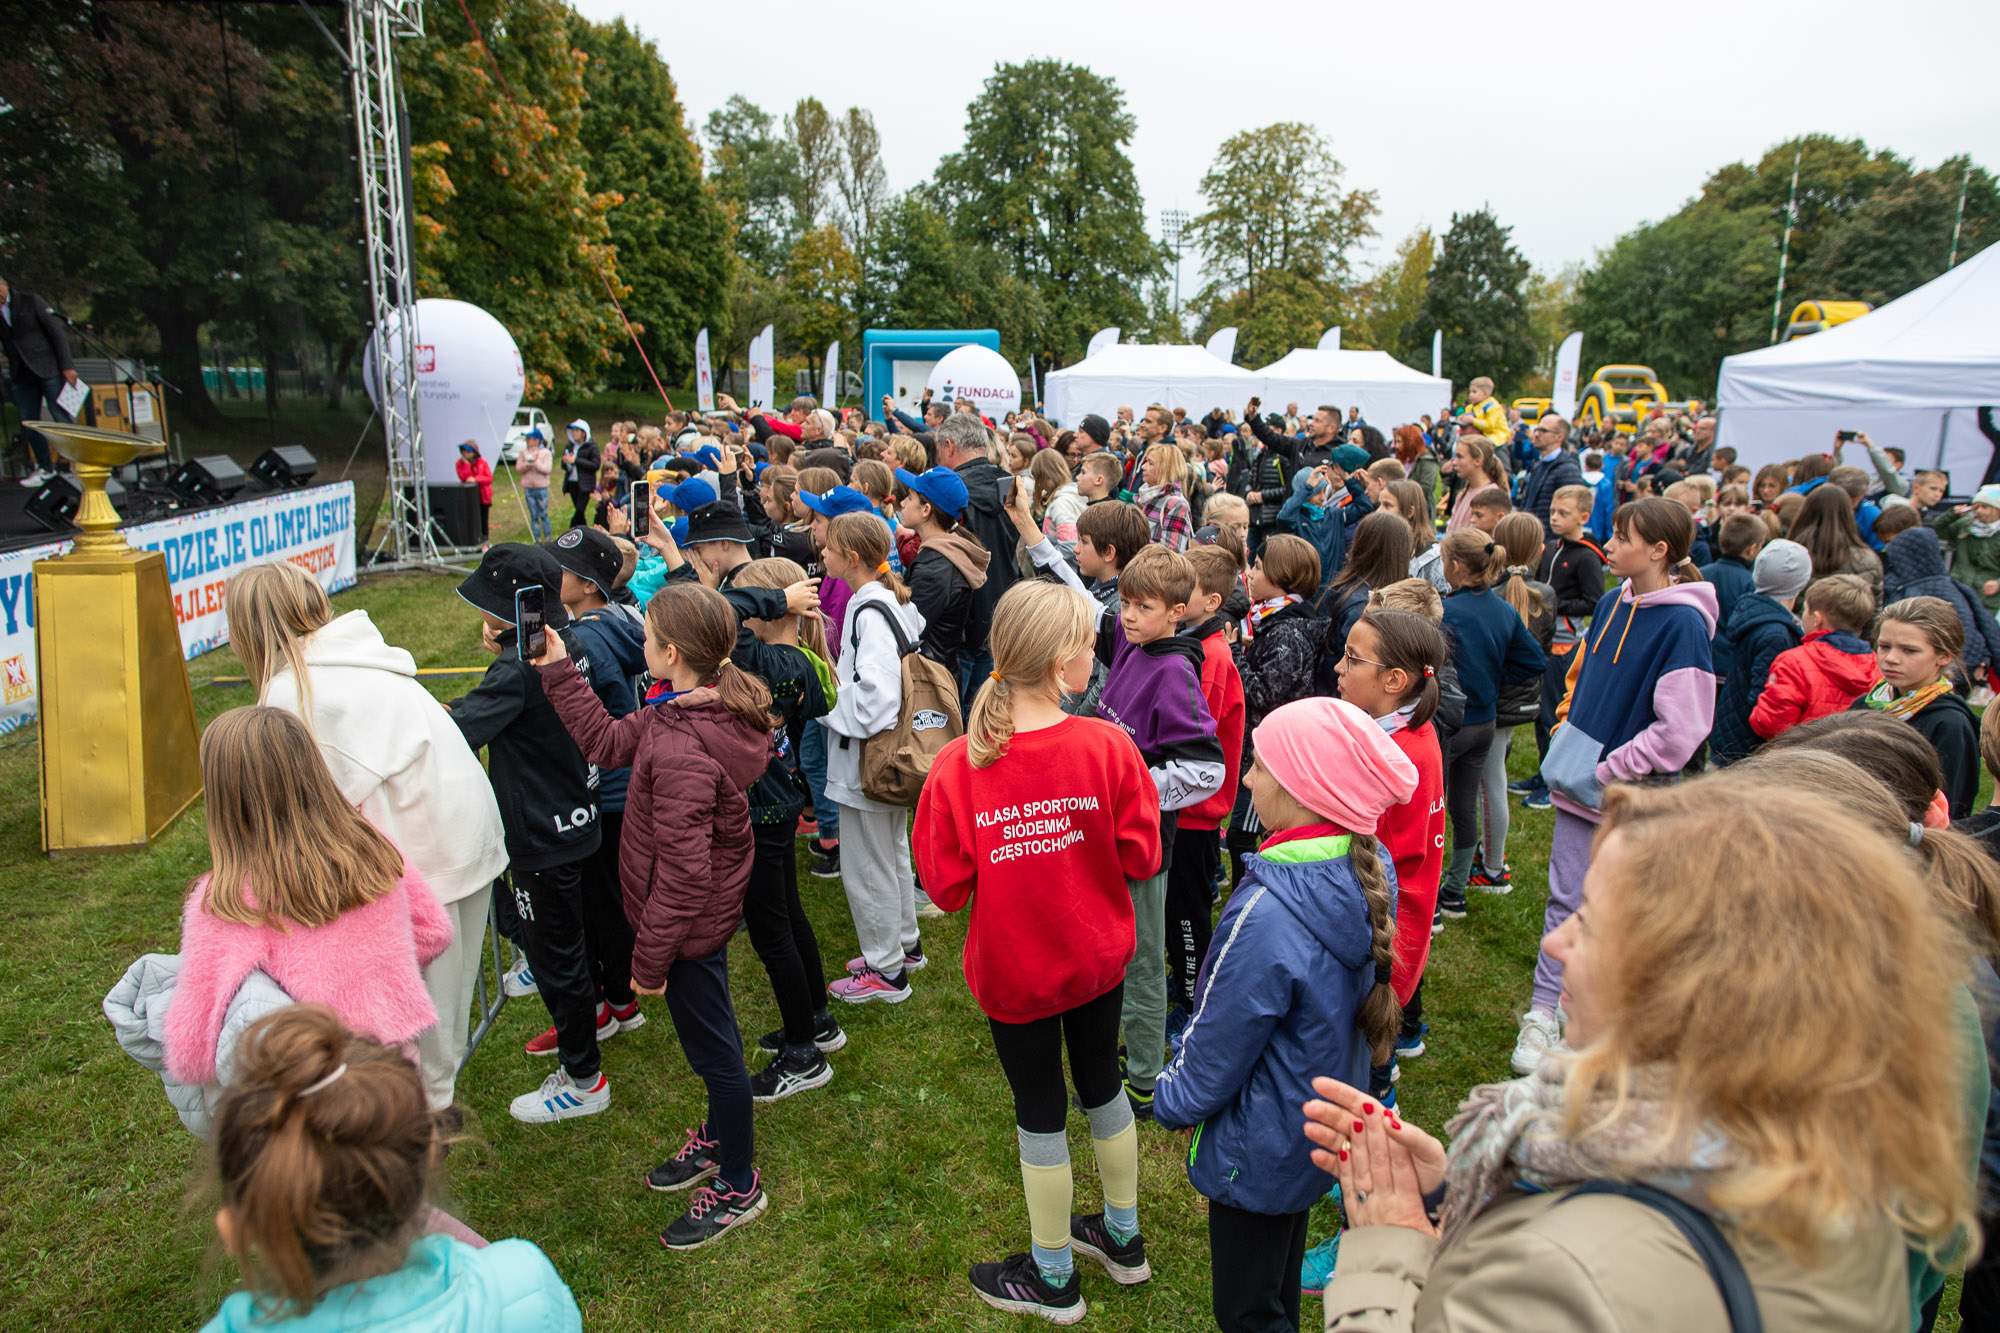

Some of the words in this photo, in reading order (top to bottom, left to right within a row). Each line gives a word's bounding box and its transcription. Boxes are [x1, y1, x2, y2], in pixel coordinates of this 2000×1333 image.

[957, 386, 1014, 399] FUNDACJA
[139, 520, 246, 584] DZIEJE
[173, 579, 232, 624] AJLEP
[5, 681, 34, 703] PZLA
[975, 807, 1021, 828] KLASA
[1023, 796, 1099, 818] SPORTOWA
[1428, 796, 1445, 816] KLA
[1003, 815, 1071, 840] SIÓDEMKA
[990, 829, 1085, 864] CZĘSTOCHOWA
[1181, 919, 1196, 951] RULES
[1186, 956, 1196, 975] THE
[1185, 978, 1196, 1001] EAK
